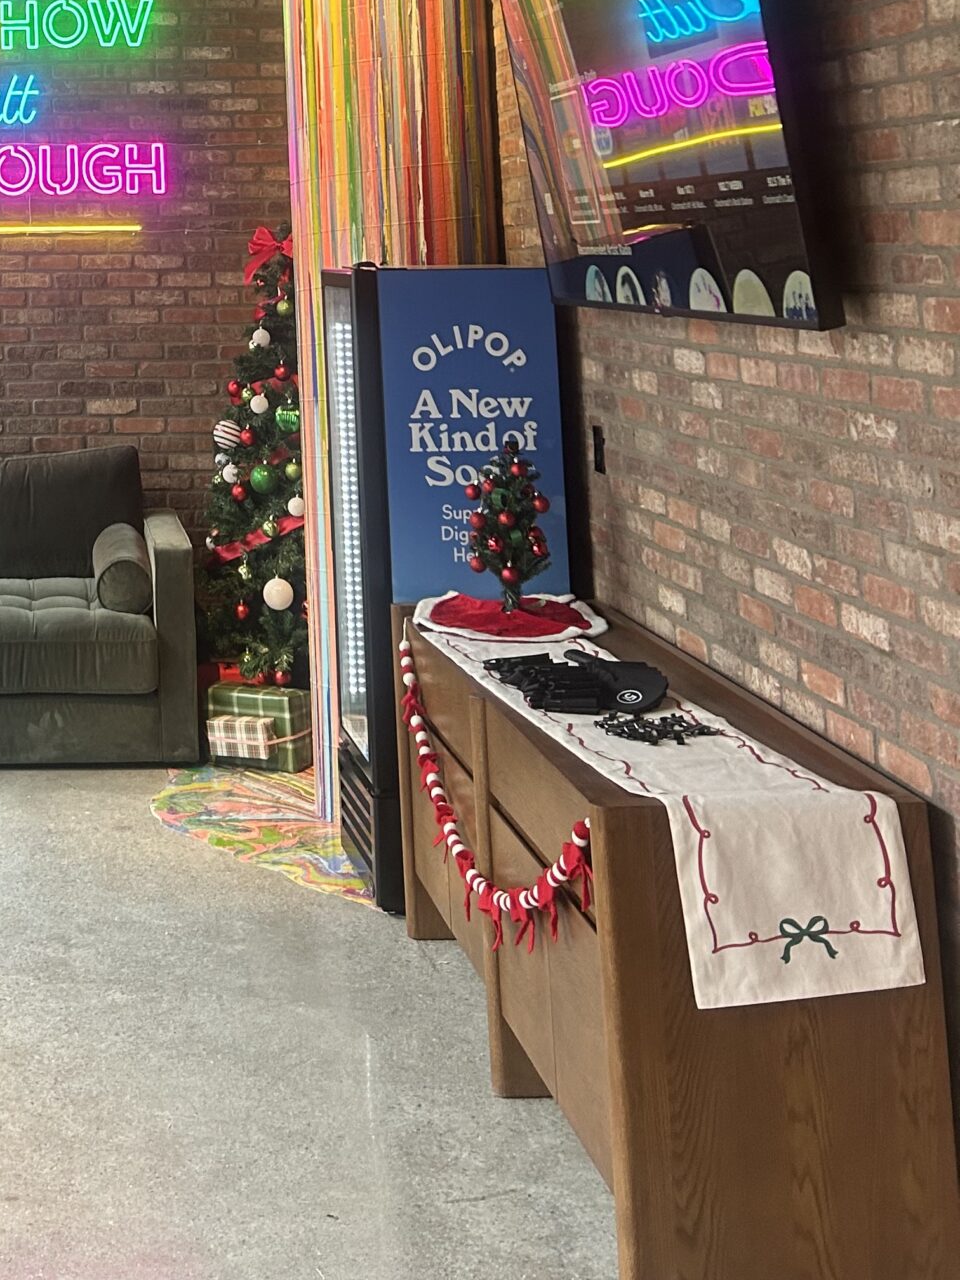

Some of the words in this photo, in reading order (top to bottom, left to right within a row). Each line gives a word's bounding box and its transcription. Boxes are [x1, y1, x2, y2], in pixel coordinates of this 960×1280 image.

[412, 324, 527, 372] OLIPOP
[410, 389, 443, 419] A
[449, 388, 533, 419] New
[408, 422, 502, 452] Kind
[502, 420, 538, 452] of
